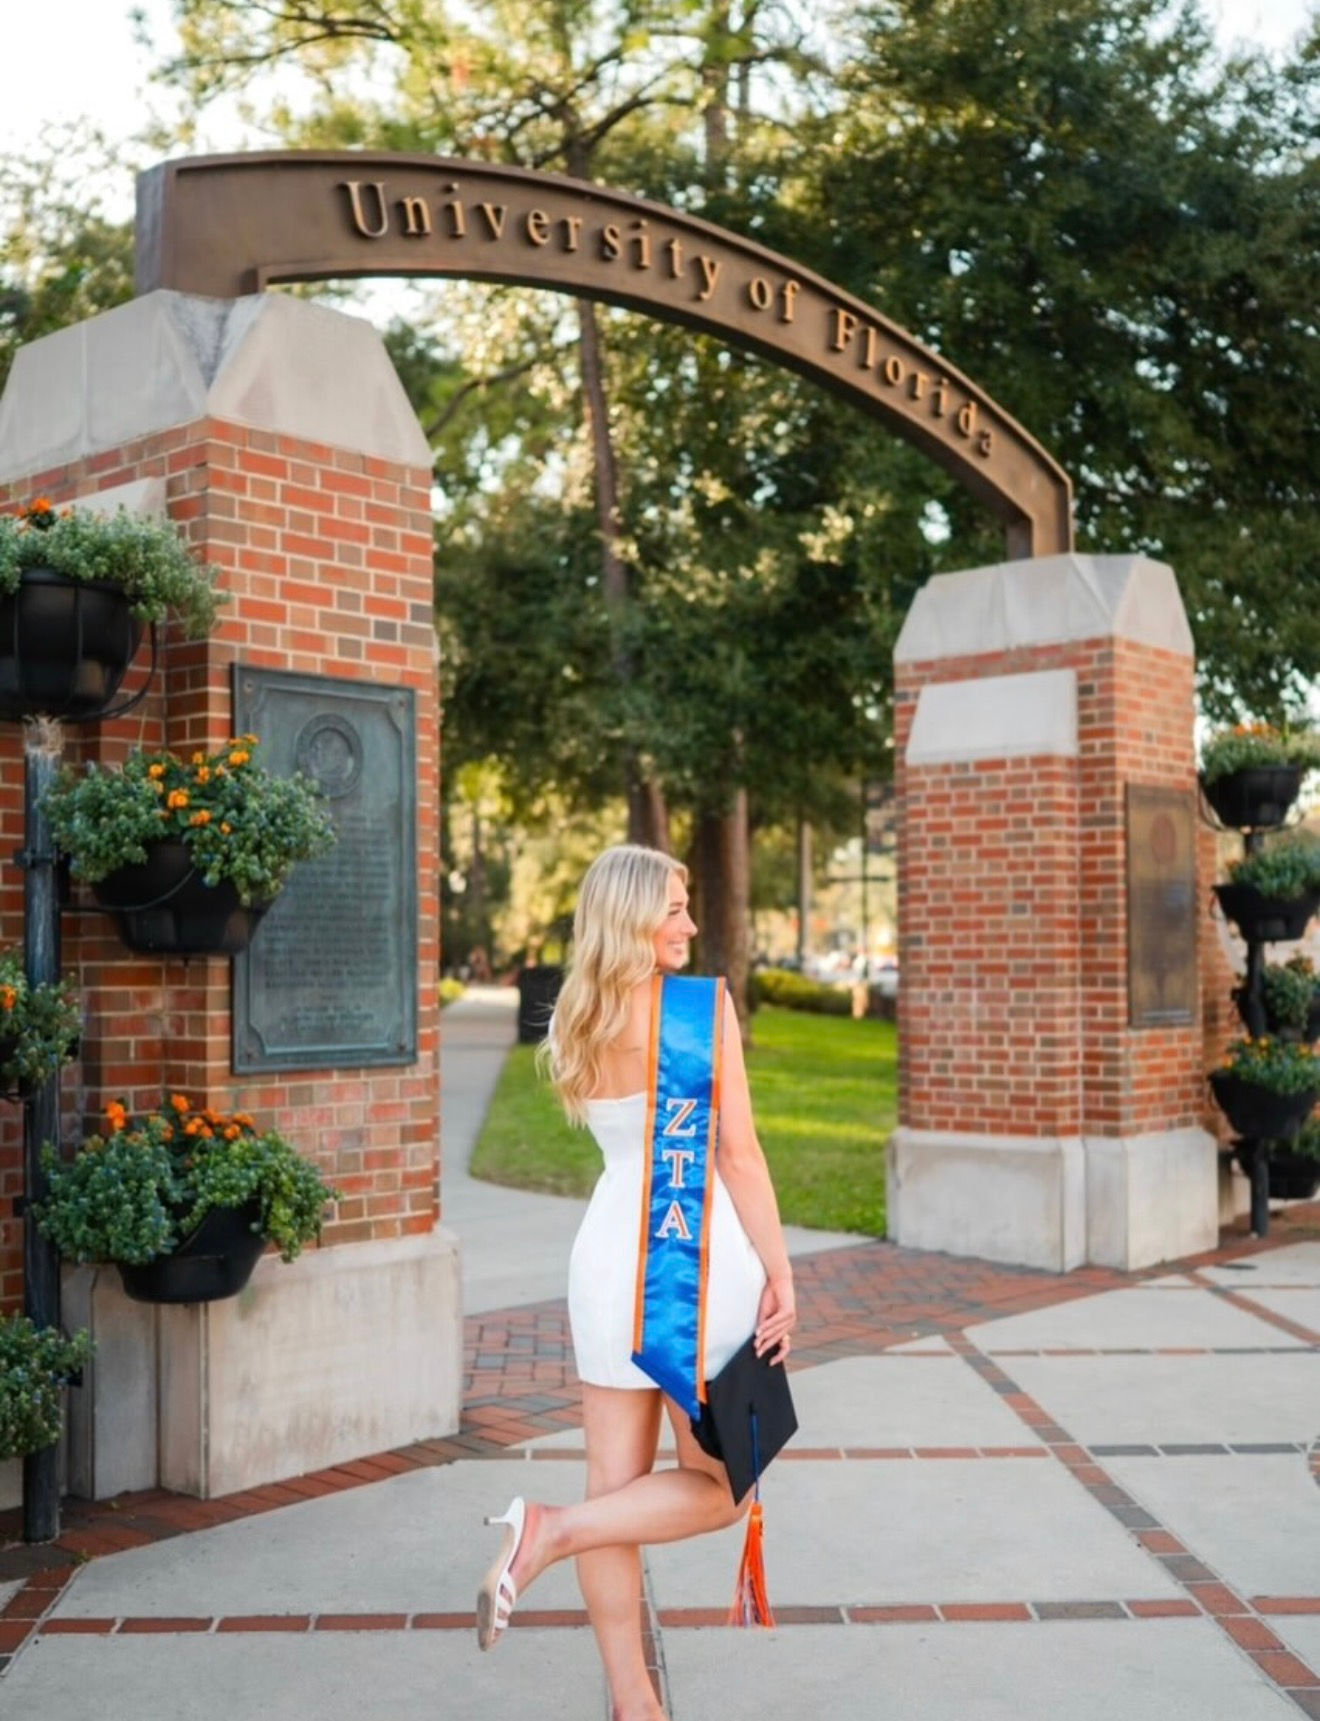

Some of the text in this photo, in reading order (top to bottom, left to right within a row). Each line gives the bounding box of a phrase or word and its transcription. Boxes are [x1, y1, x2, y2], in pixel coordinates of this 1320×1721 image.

[342, 181, 993, 456] University of Florida
[655, 1097, 698, 1240] ZTA
